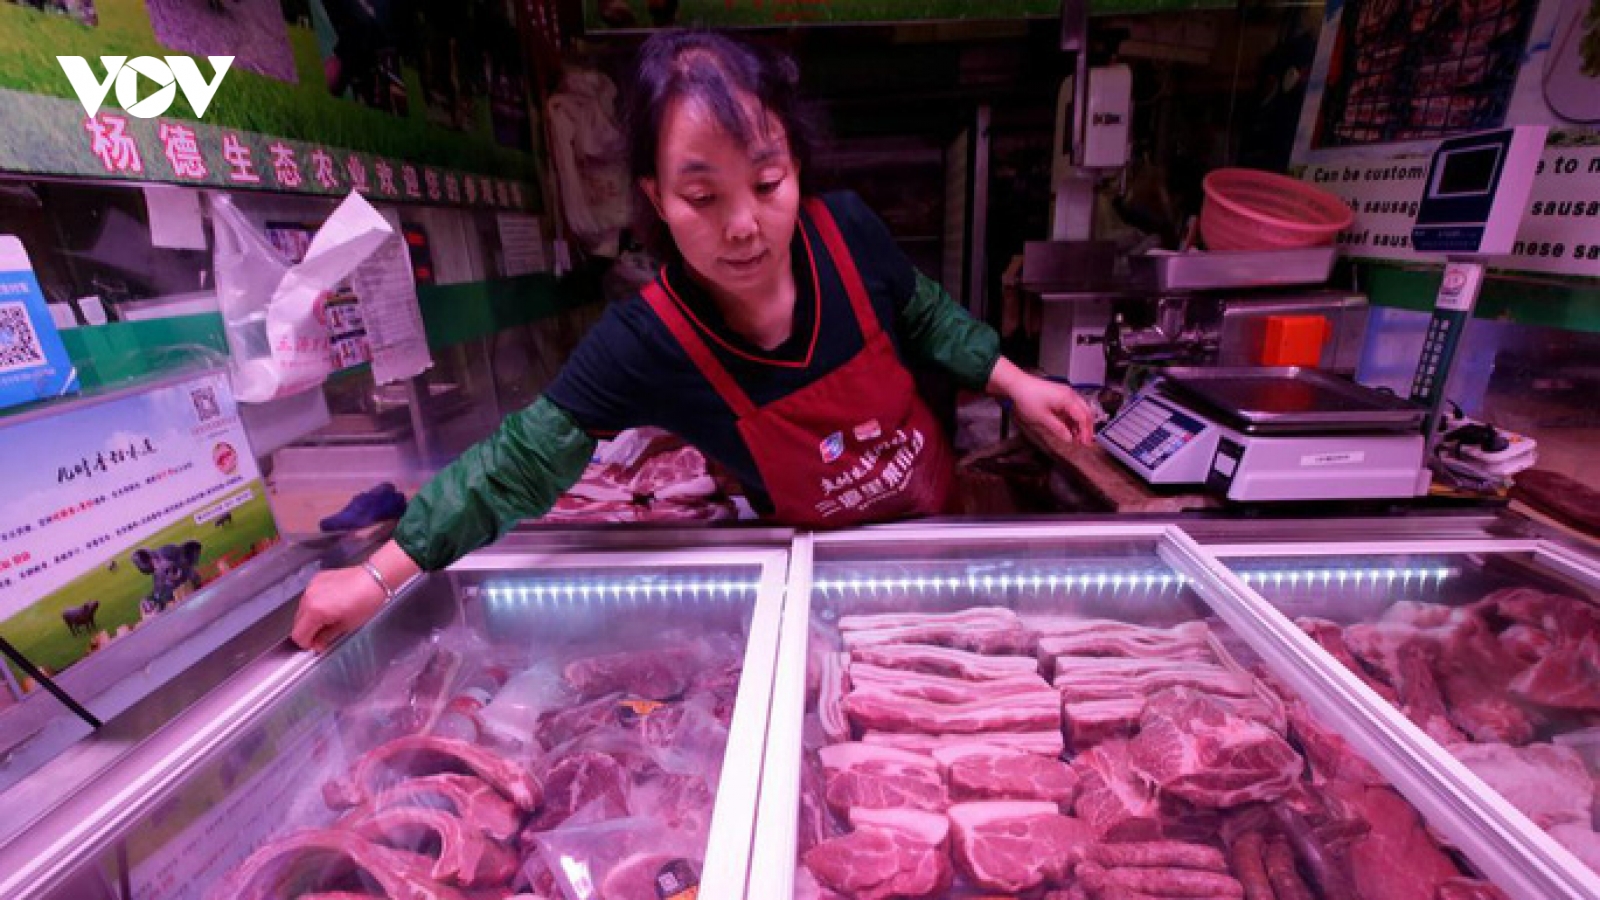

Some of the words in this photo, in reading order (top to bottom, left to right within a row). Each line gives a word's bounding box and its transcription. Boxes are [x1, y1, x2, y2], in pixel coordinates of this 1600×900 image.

[1314, 167, 1339, 183] Can
[1342, 166, 1360, 182] be
[1554, 156, 1579, 174] to
